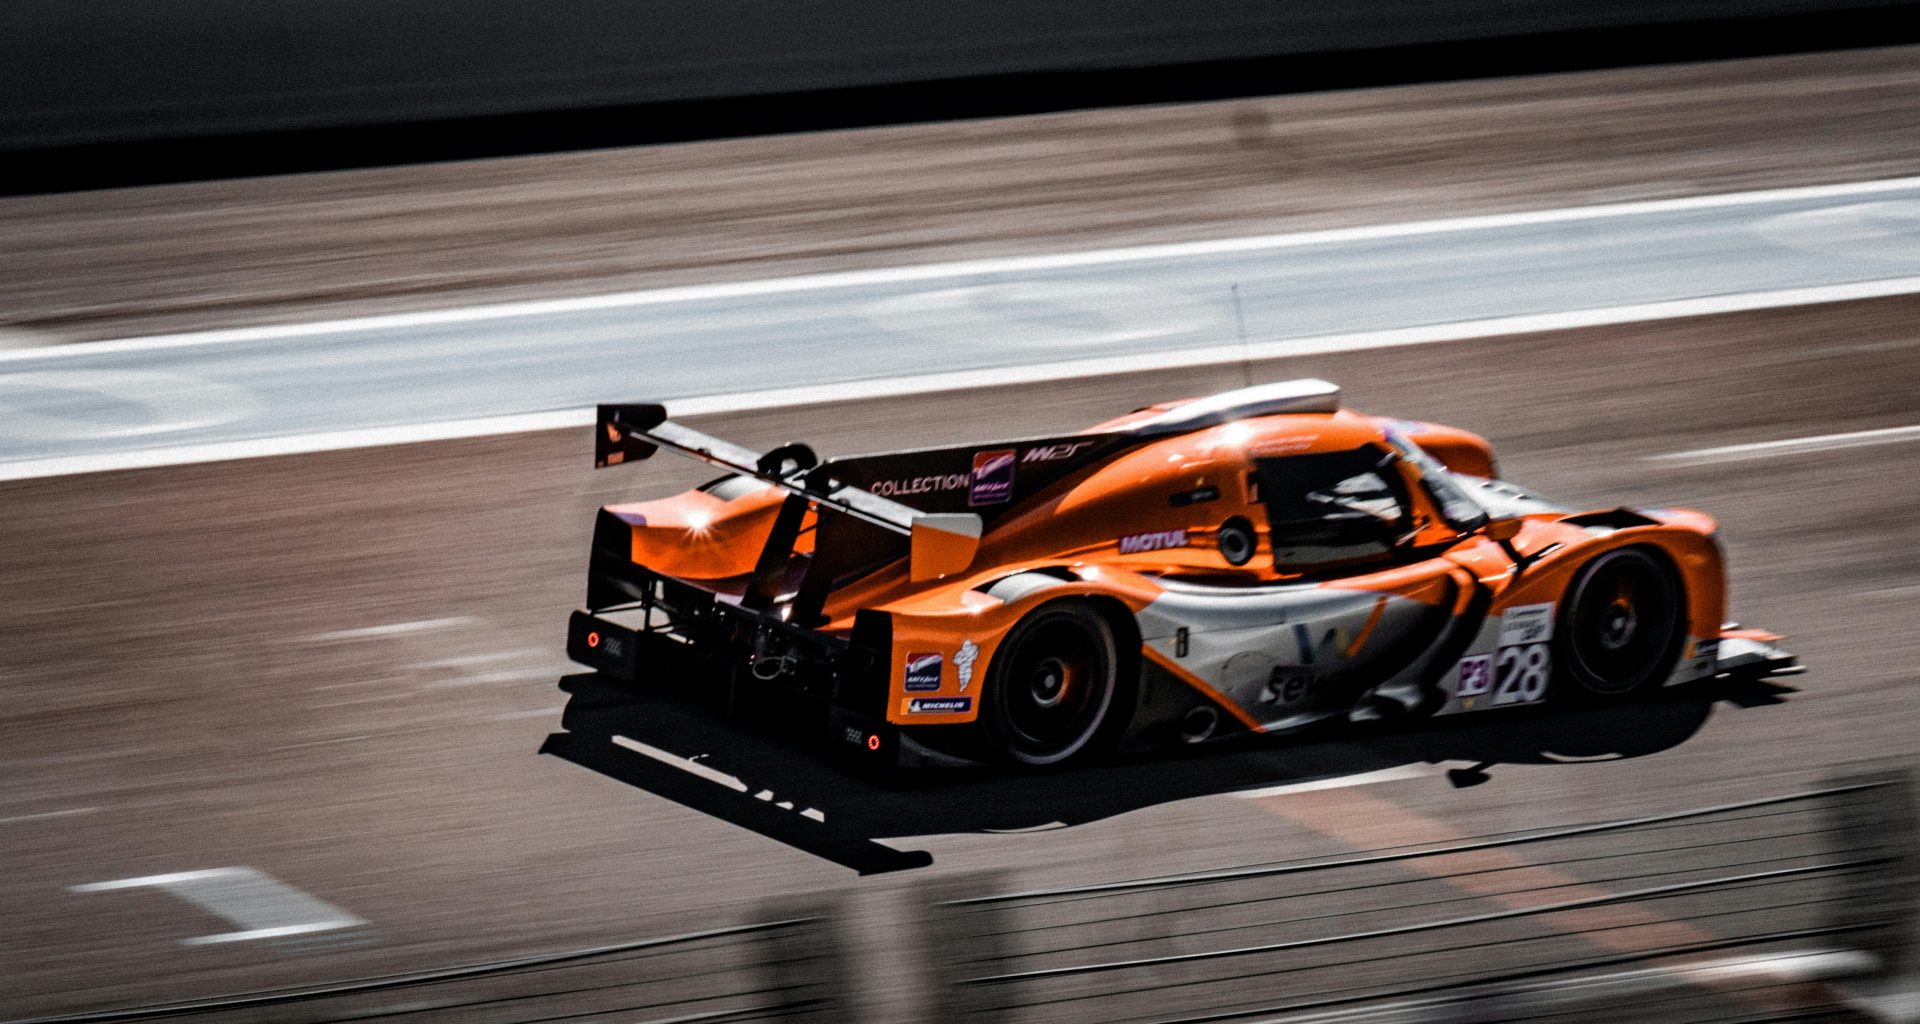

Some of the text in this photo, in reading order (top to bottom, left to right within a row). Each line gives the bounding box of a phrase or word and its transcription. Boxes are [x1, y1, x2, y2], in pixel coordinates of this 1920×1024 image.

[870, 473, 969, 497] COLLECTION
[1119, 530, 1188, 554] MOTUL
[1492, 643, 1551, 706] 28
